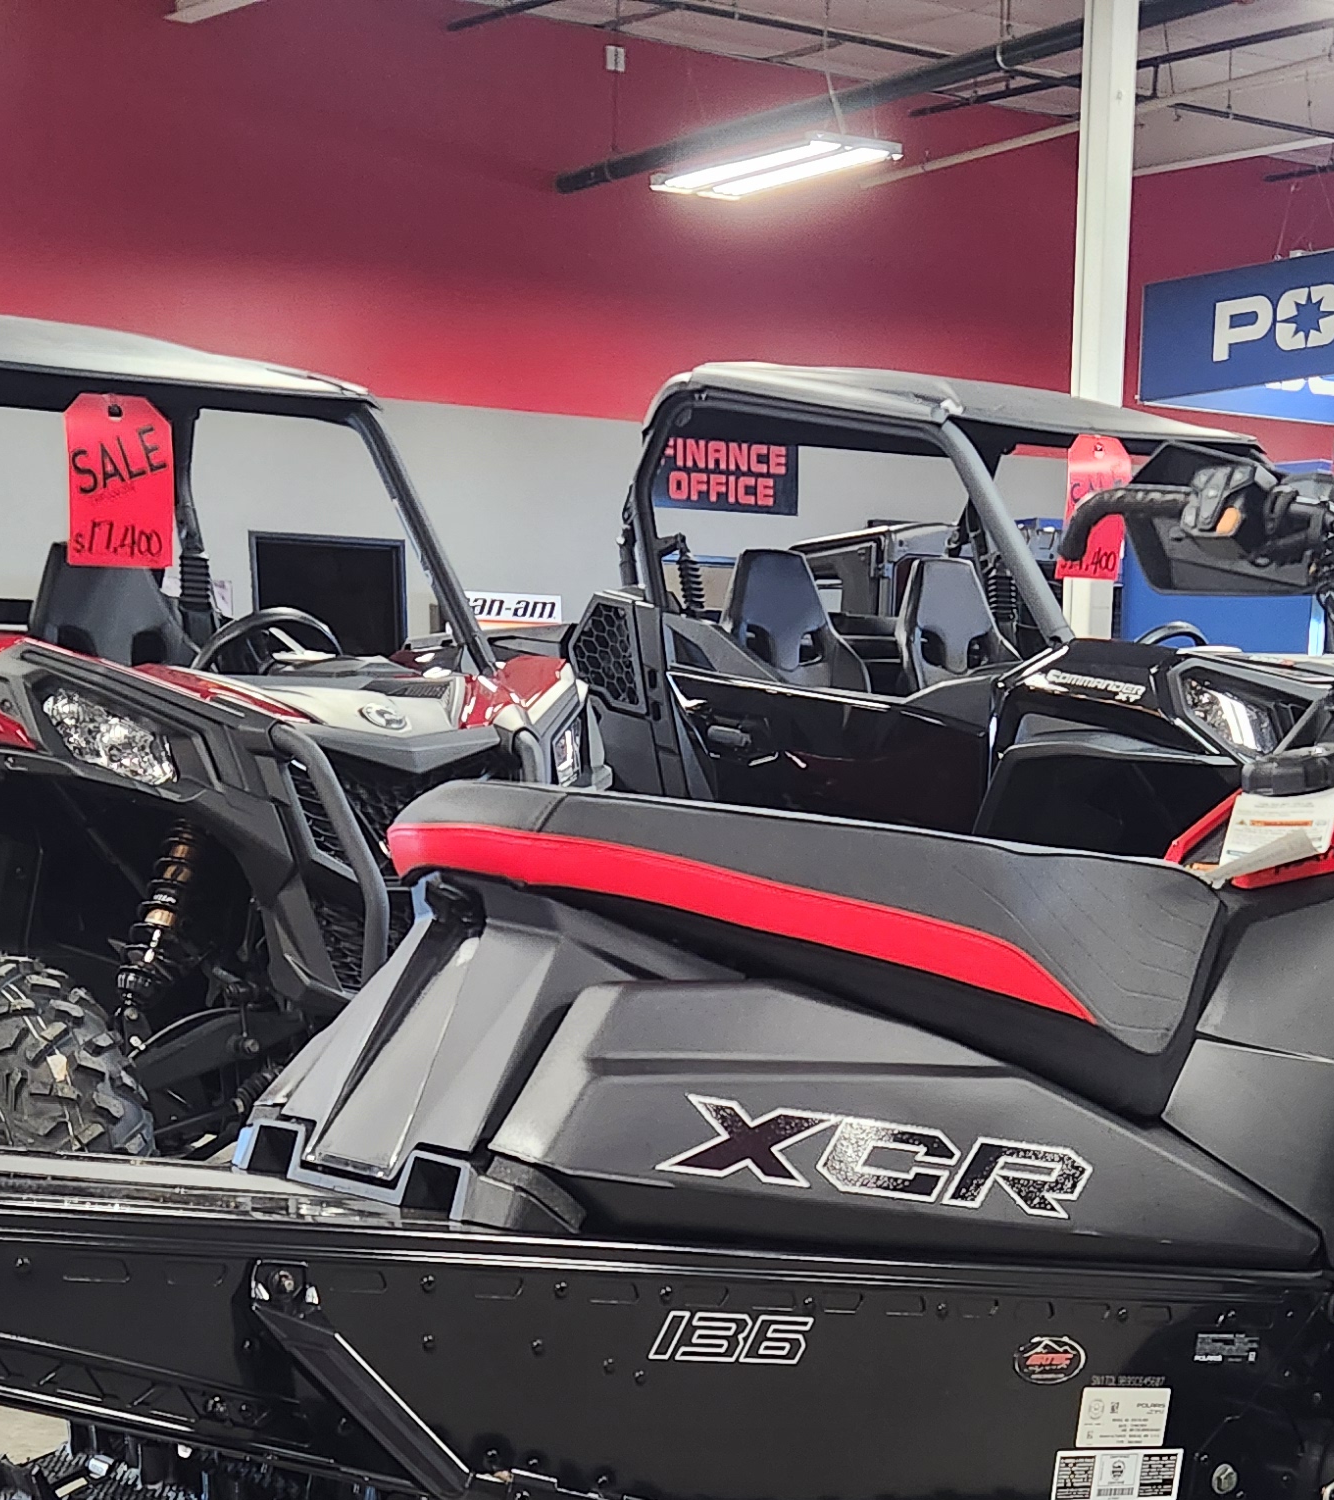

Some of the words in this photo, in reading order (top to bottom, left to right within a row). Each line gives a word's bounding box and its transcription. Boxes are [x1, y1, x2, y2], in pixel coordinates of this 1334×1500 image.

[71, 425, 168, 495] SALE
[669, 471, 774, 507] OFFICE
[468, 597, 556, 619] an-am
[1047, 669, 1146, 696] COMMANDER
[1115, 692, 1142, 702] XT
[656, 1094, 1094, 1219] XCR
[648, 1310, 814, 1365] 136
